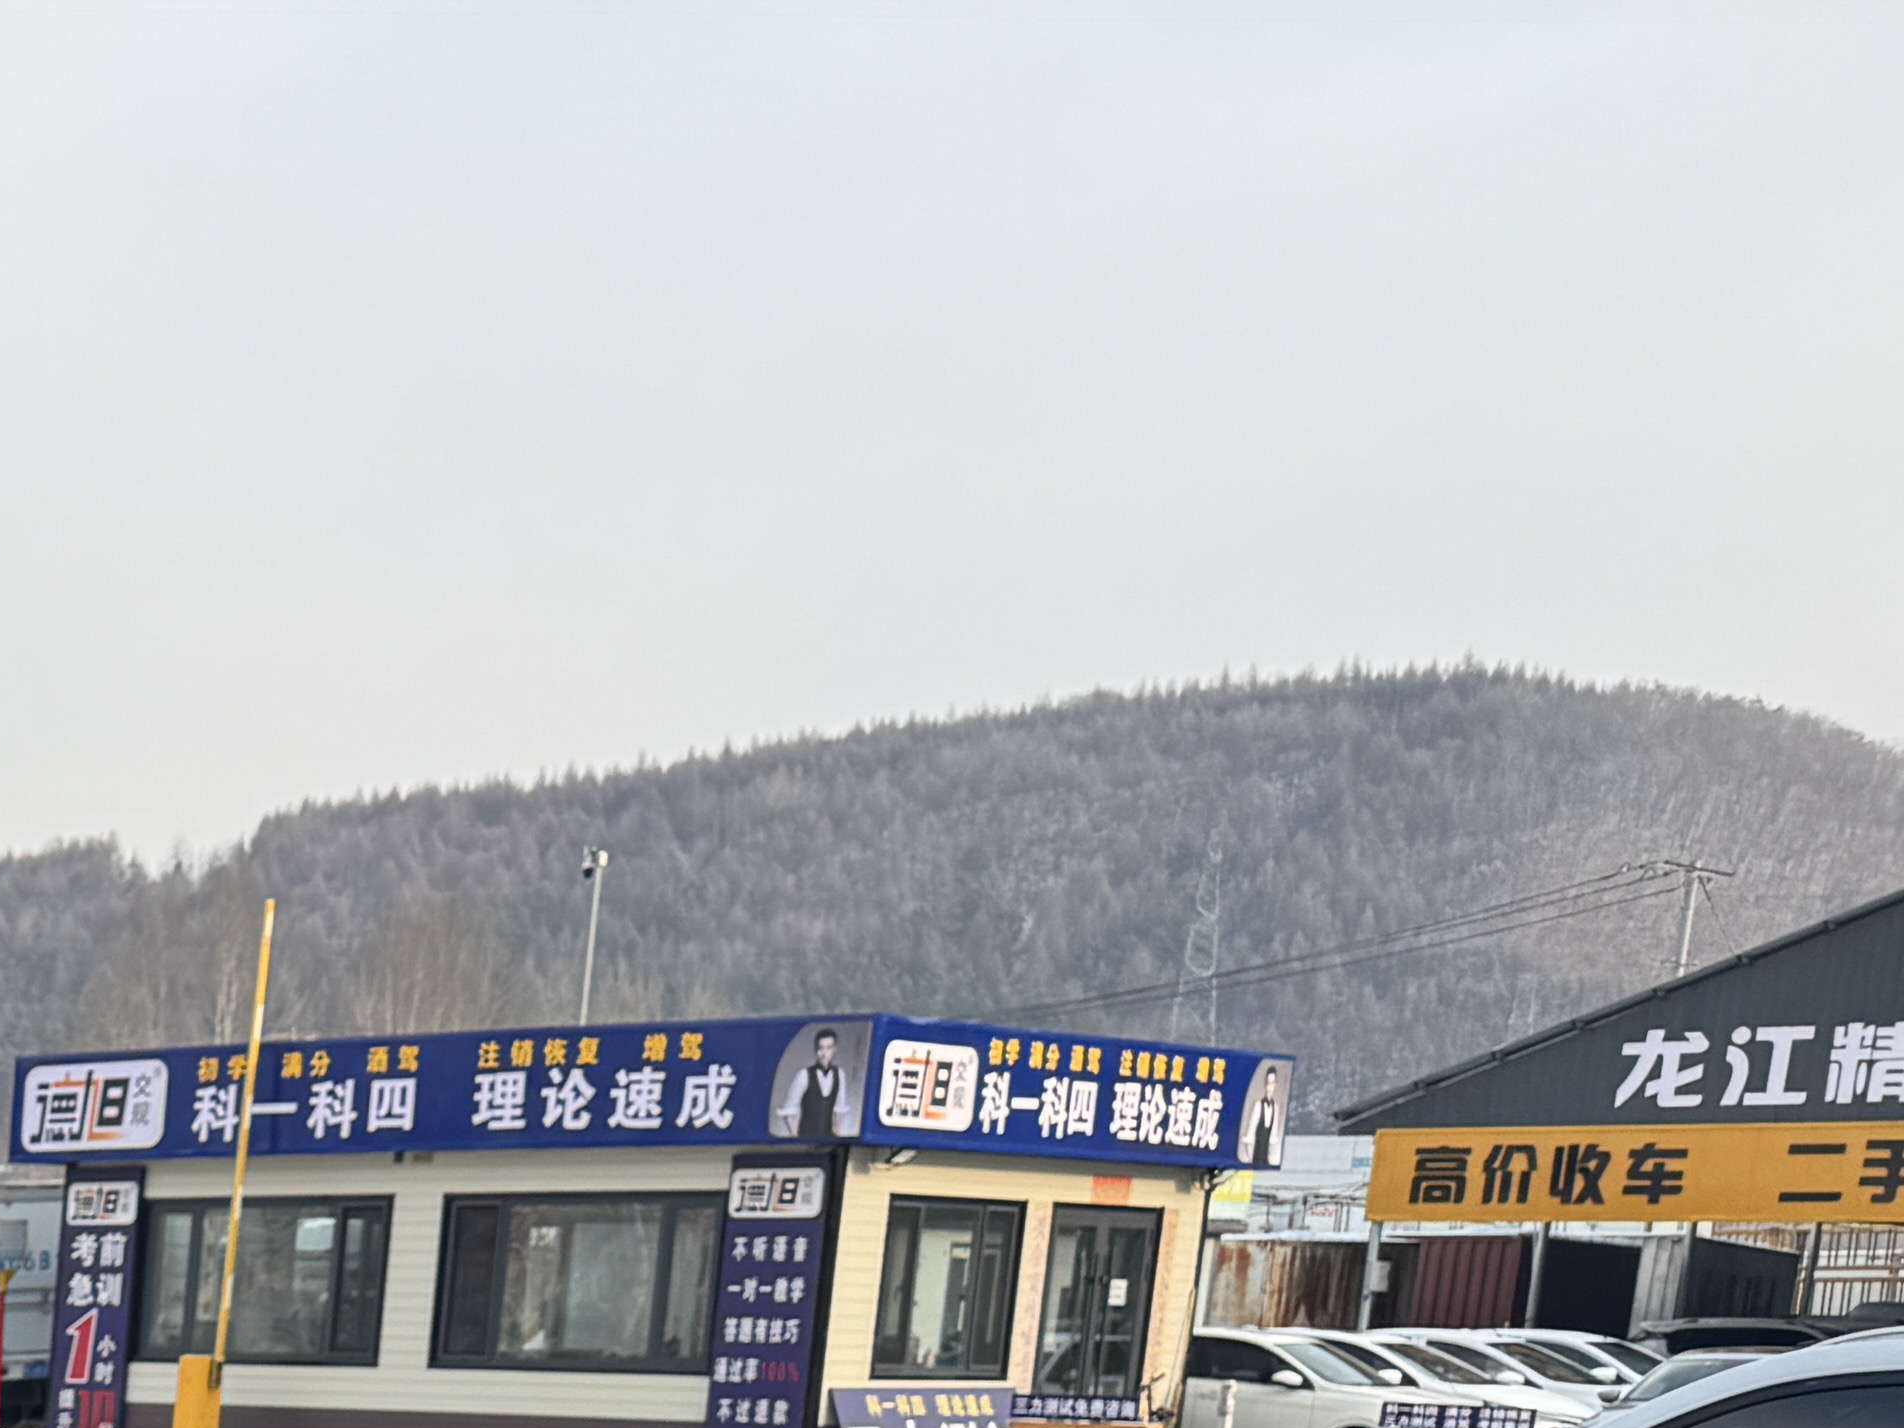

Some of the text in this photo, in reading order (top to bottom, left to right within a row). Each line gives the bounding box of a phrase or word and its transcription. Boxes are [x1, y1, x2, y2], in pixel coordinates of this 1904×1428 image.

[478, 1036, 600, 1069] 注销恢复
[1614, 1021, 1904, 1109] 龙江精
[192, 1063, 737, 1143] 科一科四 理论速成
[979, 1071, 1225, 1151] 科一科四 理论速成
[1408, 1139, 1904, 1205] 高价收车 二手
[70, 1231, 129, 1268] 考前
[65, 1307, 99, 1385] 1
